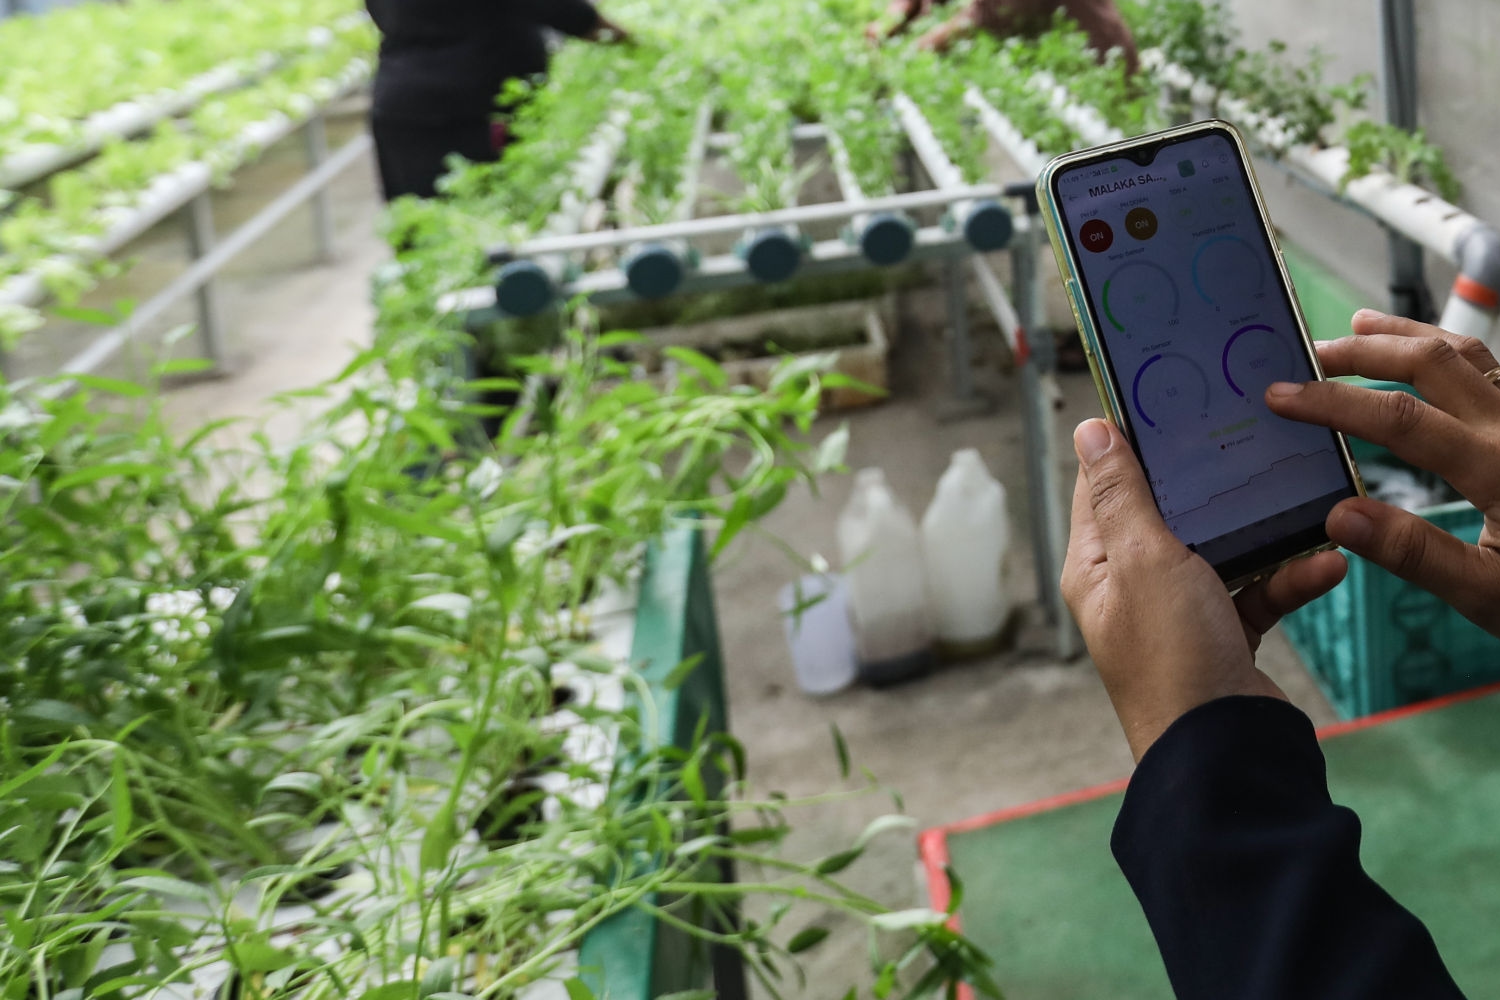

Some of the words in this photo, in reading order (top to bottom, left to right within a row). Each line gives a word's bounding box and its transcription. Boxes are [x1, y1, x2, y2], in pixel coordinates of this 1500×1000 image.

[1088, 178, 1137, 198] MALAKA
[1135, 219, 1149, 230] ON
[1089, 231, 1105, 242] ON
